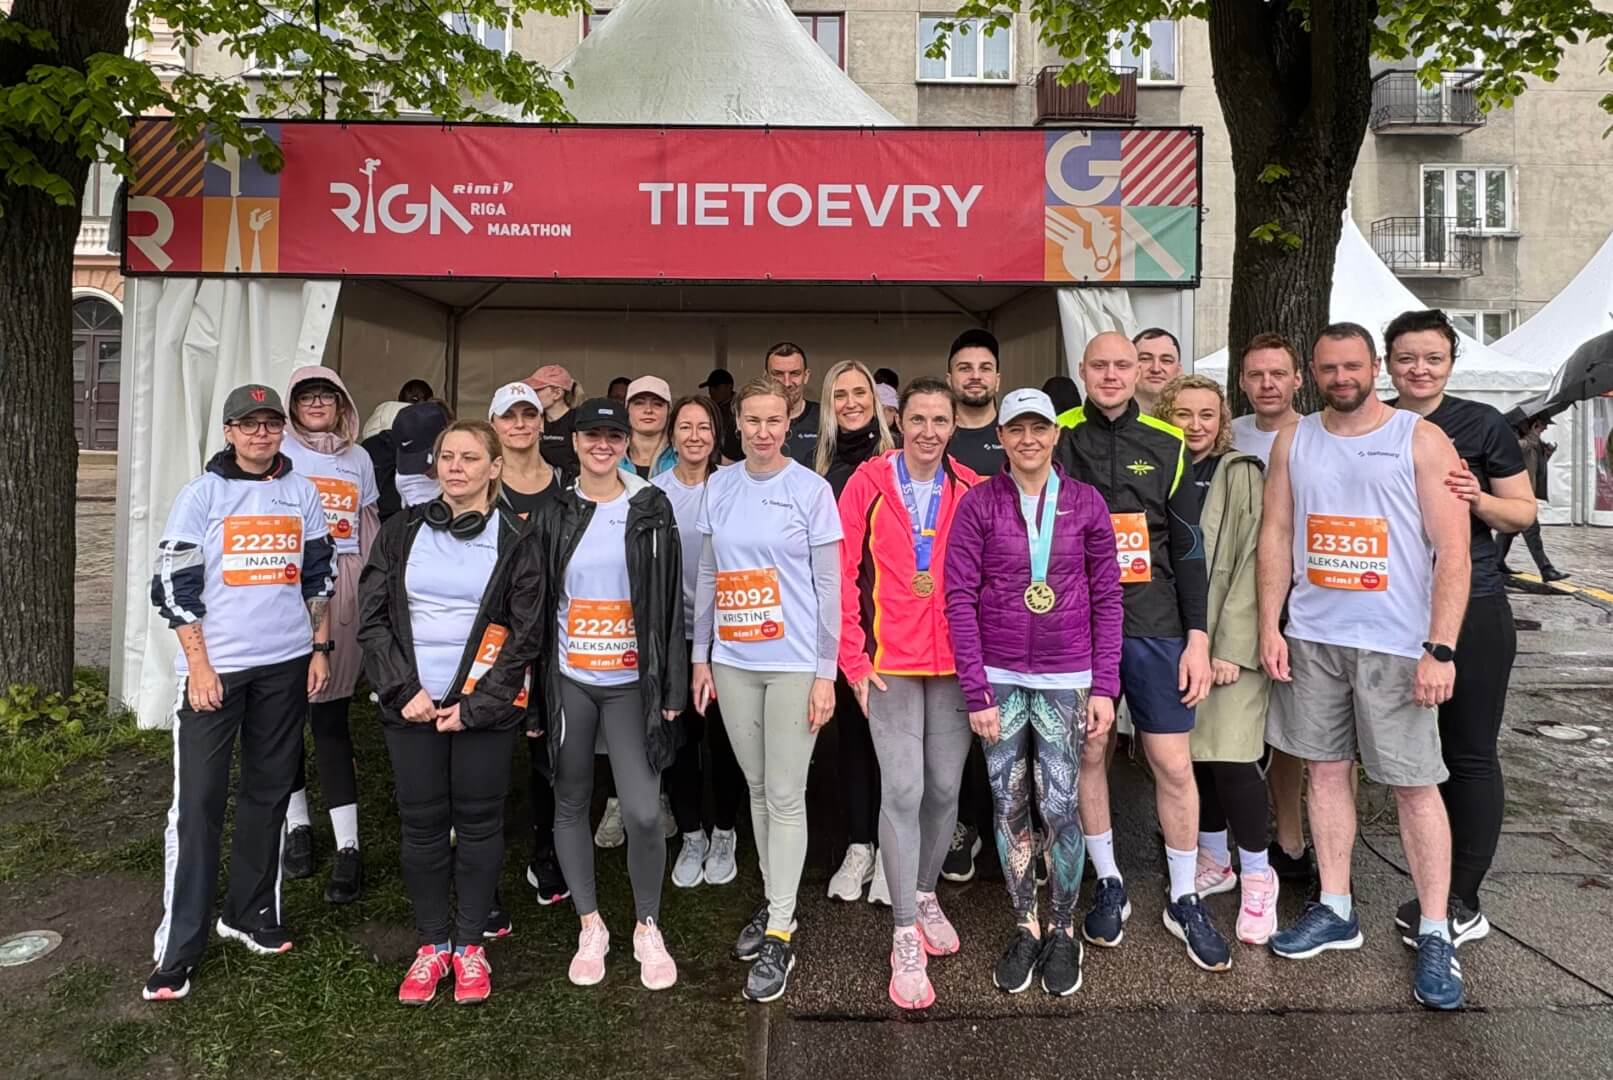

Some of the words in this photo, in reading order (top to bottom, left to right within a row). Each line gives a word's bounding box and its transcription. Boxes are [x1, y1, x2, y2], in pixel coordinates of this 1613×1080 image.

[330, 177, 474, 235] RIGA
[470, 202, 507, 216] RIGA
[638, 182, 984, 227] TIETOEVRY
[487, 223, 572, 237] MARATHON
[231, 533, 298, 551] 22236
[1311, 532, 1379, 555] 23361
[1308, 556, 1388, 571] ALEKSANDRS
[716, 586, 776, 608] 23092
[568, 640, 638, 651] ALEKSANDR
